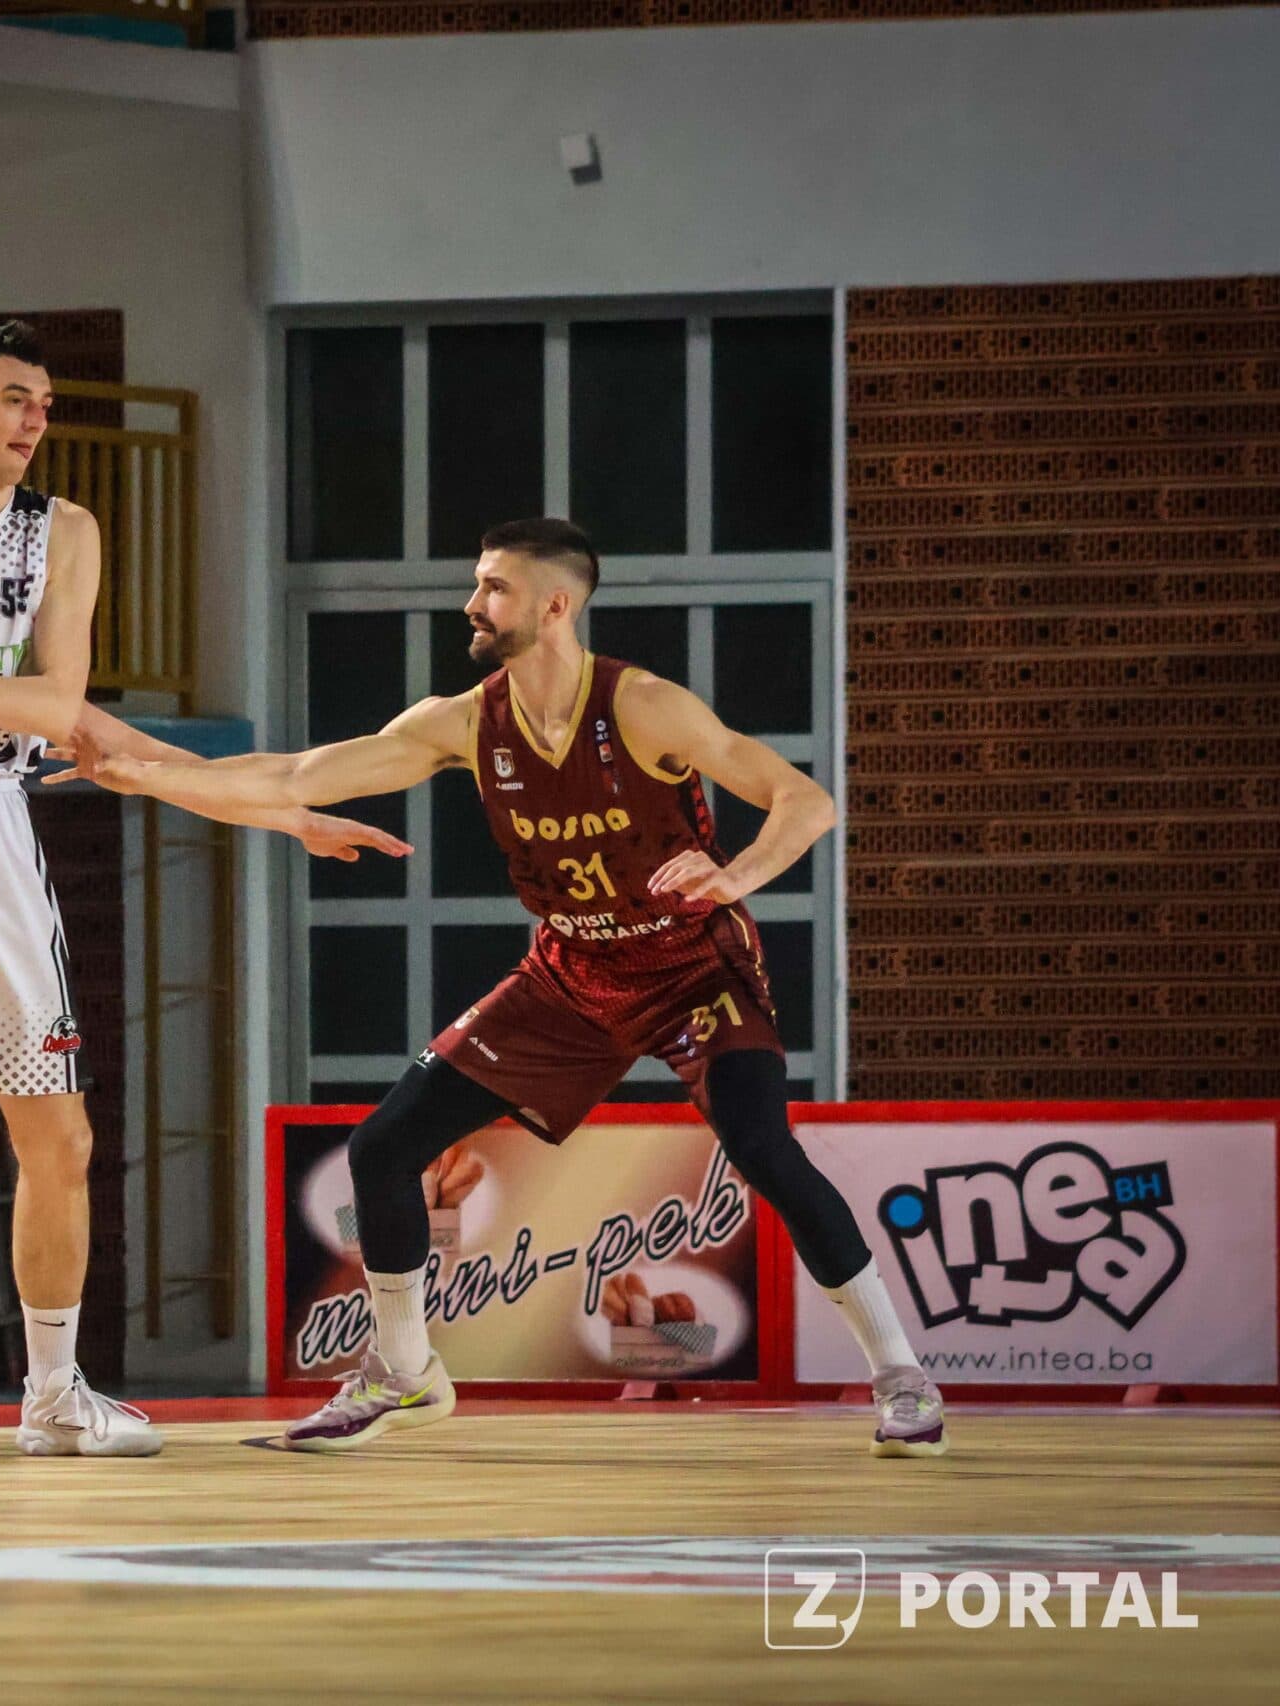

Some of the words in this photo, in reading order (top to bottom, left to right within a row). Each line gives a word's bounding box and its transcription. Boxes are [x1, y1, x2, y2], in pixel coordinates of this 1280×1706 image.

[0, 573, 35, 618] 55
[510, 807, 631, 841] bosna
[558, 852, 616, 901] 31
[569, 913, 615, 928] VISIT
[579, 915, 672, 941] SARAJEVO
[691, 991, 743, 1042] 31
[1114, 1173, 1161, 1203] BH
[914, 1346, 1153, 1371] www.intea.ba
